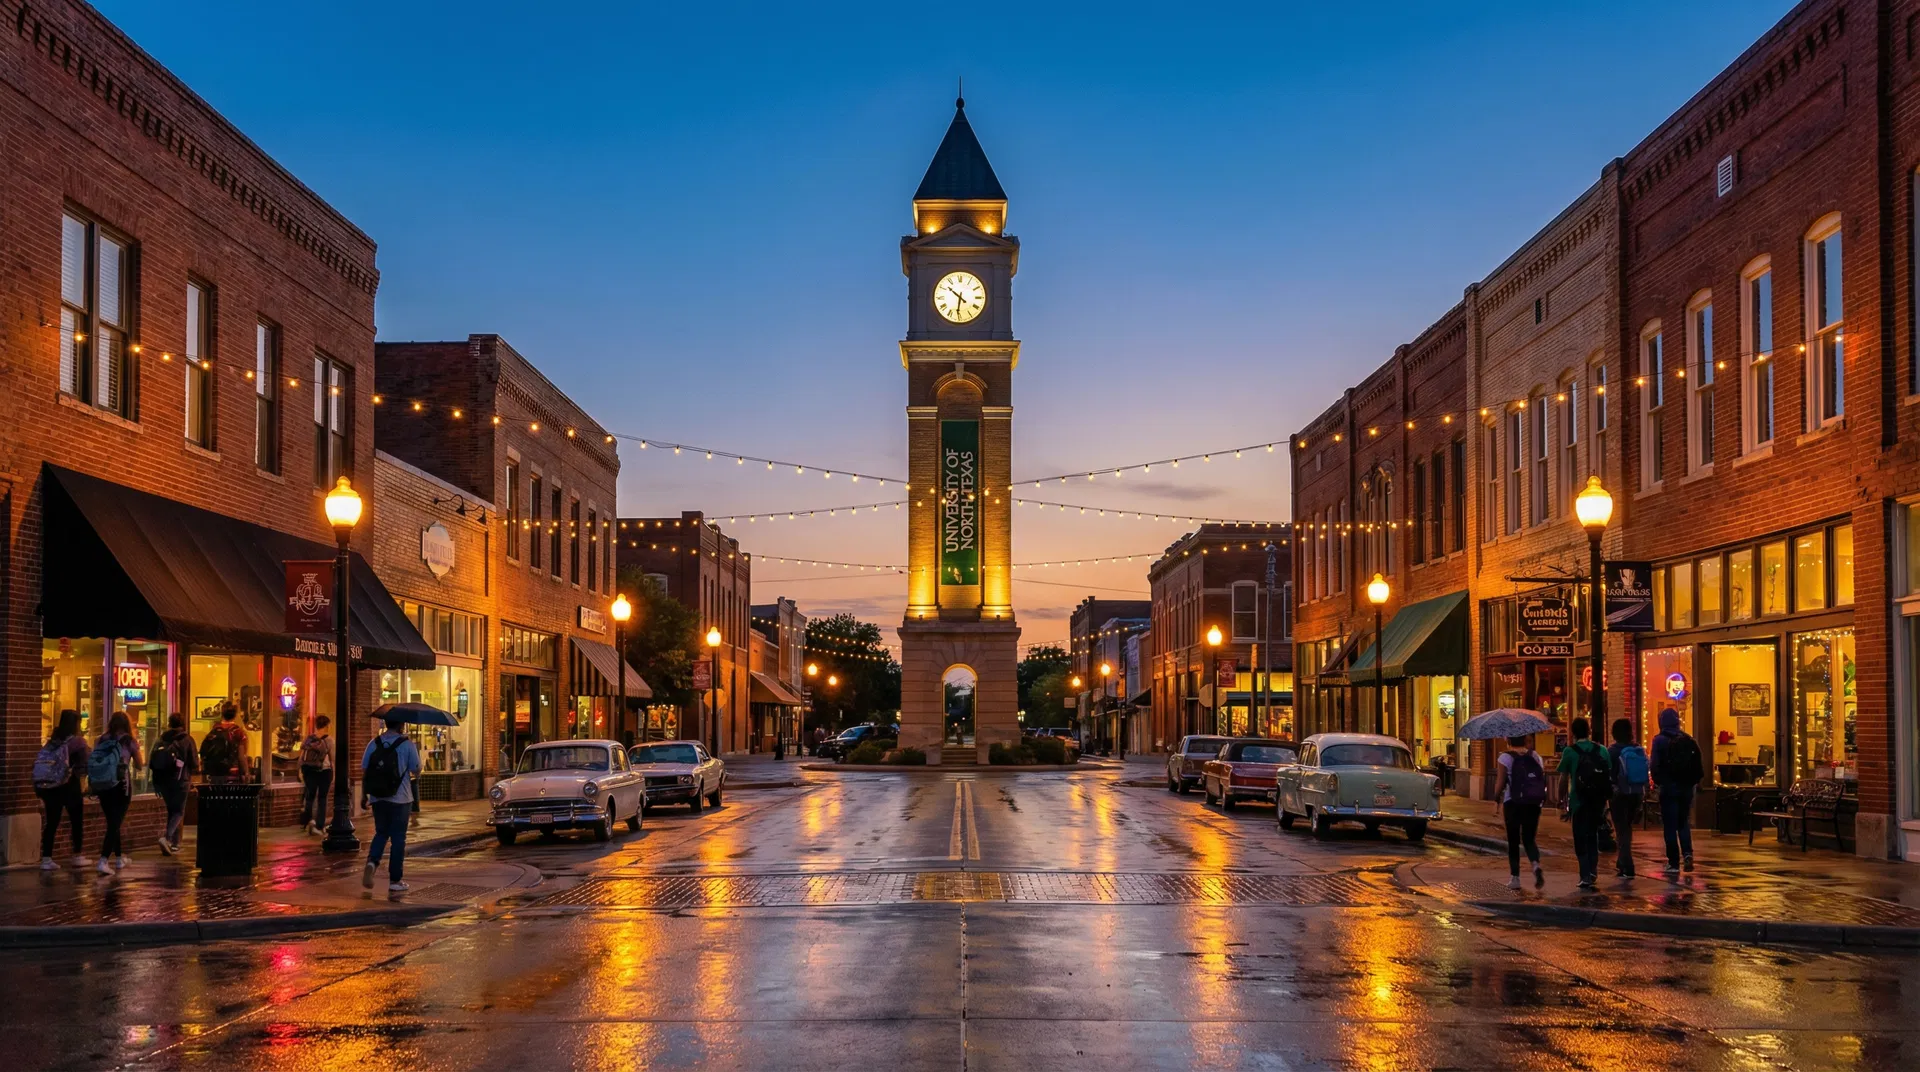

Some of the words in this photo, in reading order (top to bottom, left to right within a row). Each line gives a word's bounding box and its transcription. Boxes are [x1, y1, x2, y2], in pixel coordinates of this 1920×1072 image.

[946, 448, 959, 468] OF
[960, 451, 973, 495] TEXAS
[945, 470, 959, 553] UNIVERSITY
[960, 498, 973, 550] NORTH
[121, 667, 149, 687] OPEN
